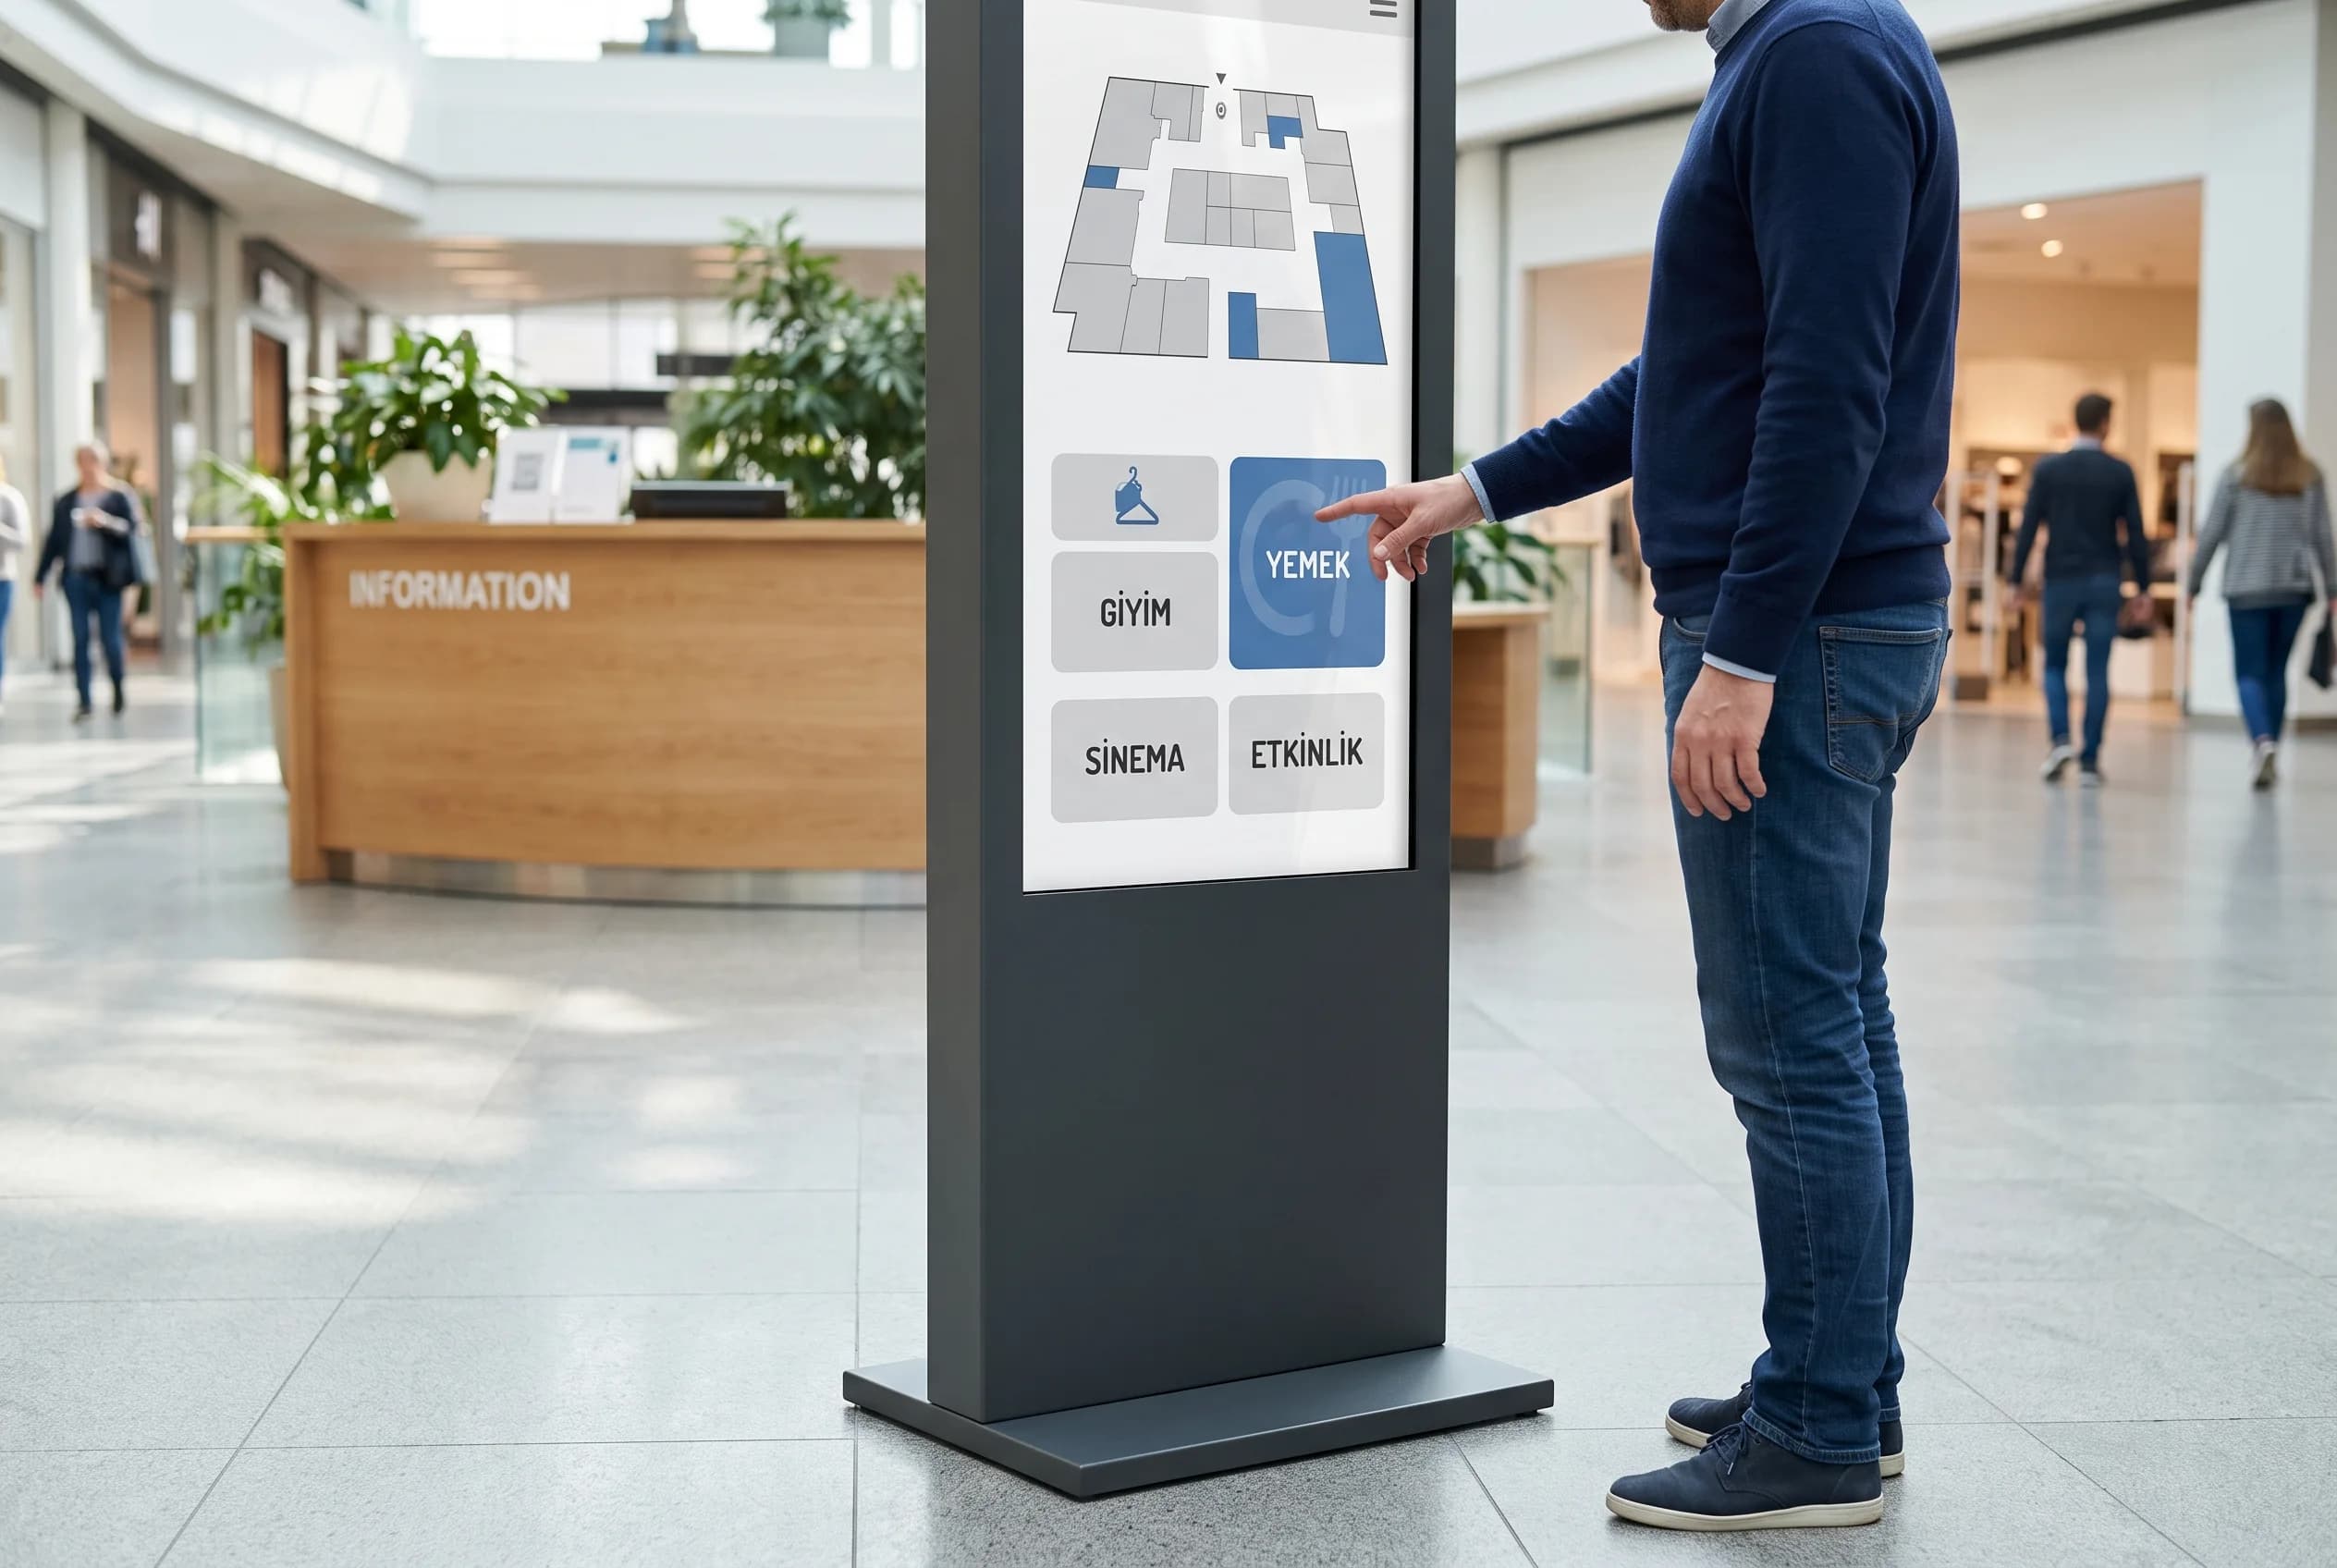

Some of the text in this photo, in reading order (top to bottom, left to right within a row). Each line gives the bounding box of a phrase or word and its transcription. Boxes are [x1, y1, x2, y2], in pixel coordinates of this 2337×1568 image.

[1266, 550, 1351, 579] YEMEK
[349, 570, 570, 610] INFORMATION
[1100, 590, 1171, 627] GİYİM
[1085, 738, 1185, 775] SİNEMA
[1252, 730, 1364, 768] ETKİNLİK
